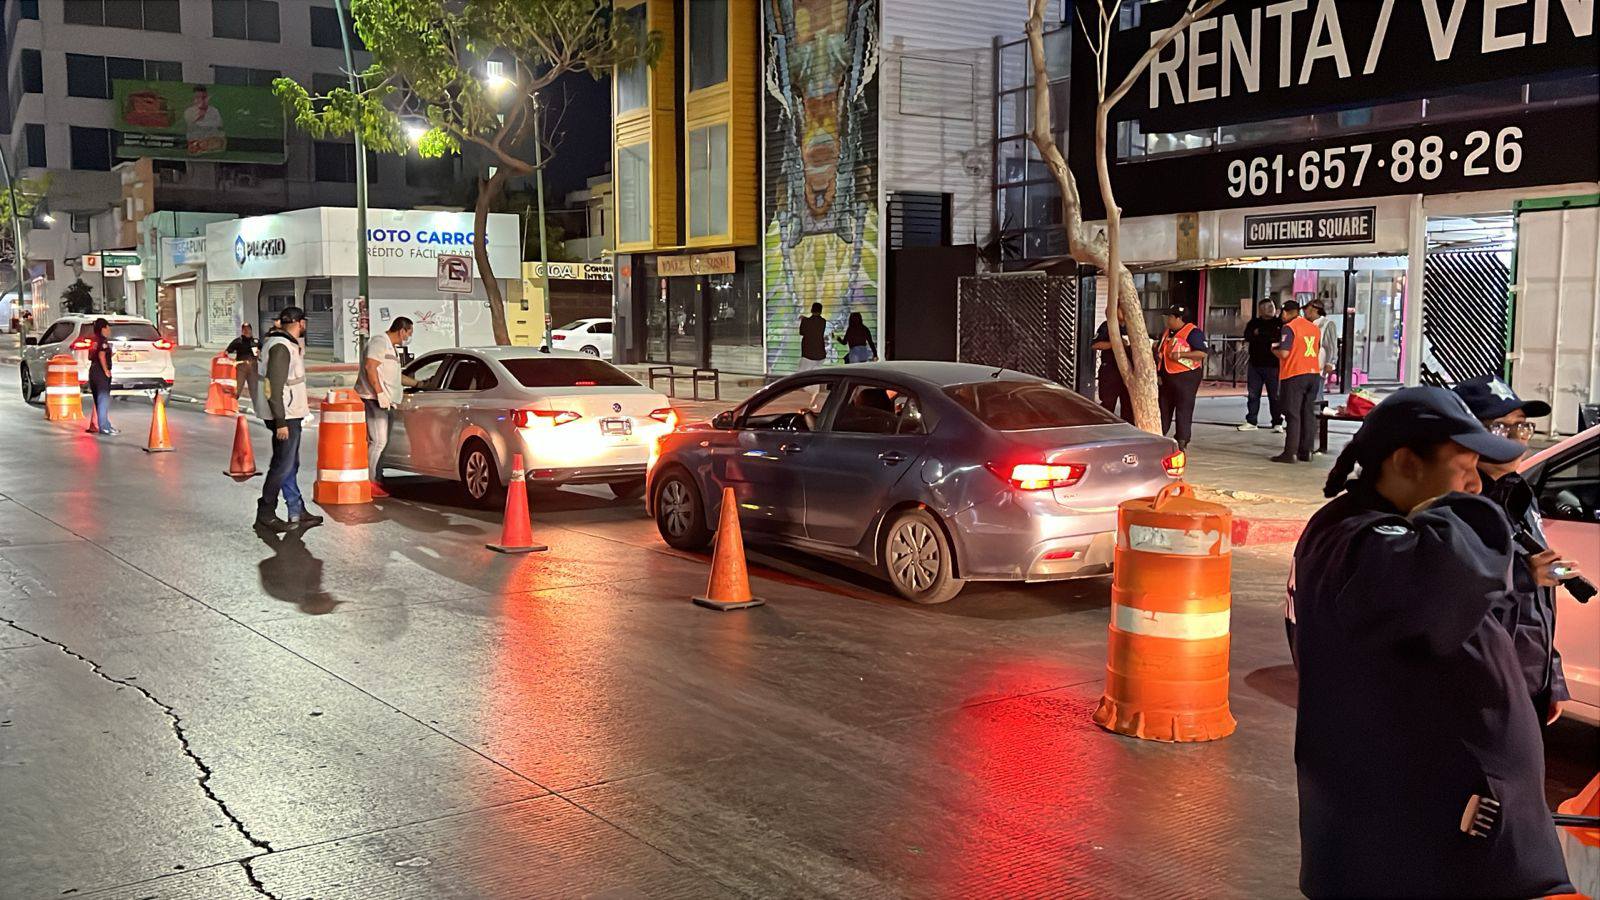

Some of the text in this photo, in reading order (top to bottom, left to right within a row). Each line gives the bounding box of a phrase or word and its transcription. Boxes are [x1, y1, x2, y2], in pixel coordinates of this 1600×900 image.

[1149, 0, 1352, 109] RENTA
[367, 229, 411, 242] OTO
[1250, 215, 1368, 241] CONTEINER SQUARE
[368, 247, 404, 257] RÉDITO
[410, 248, 438, 258] FÁCIL
